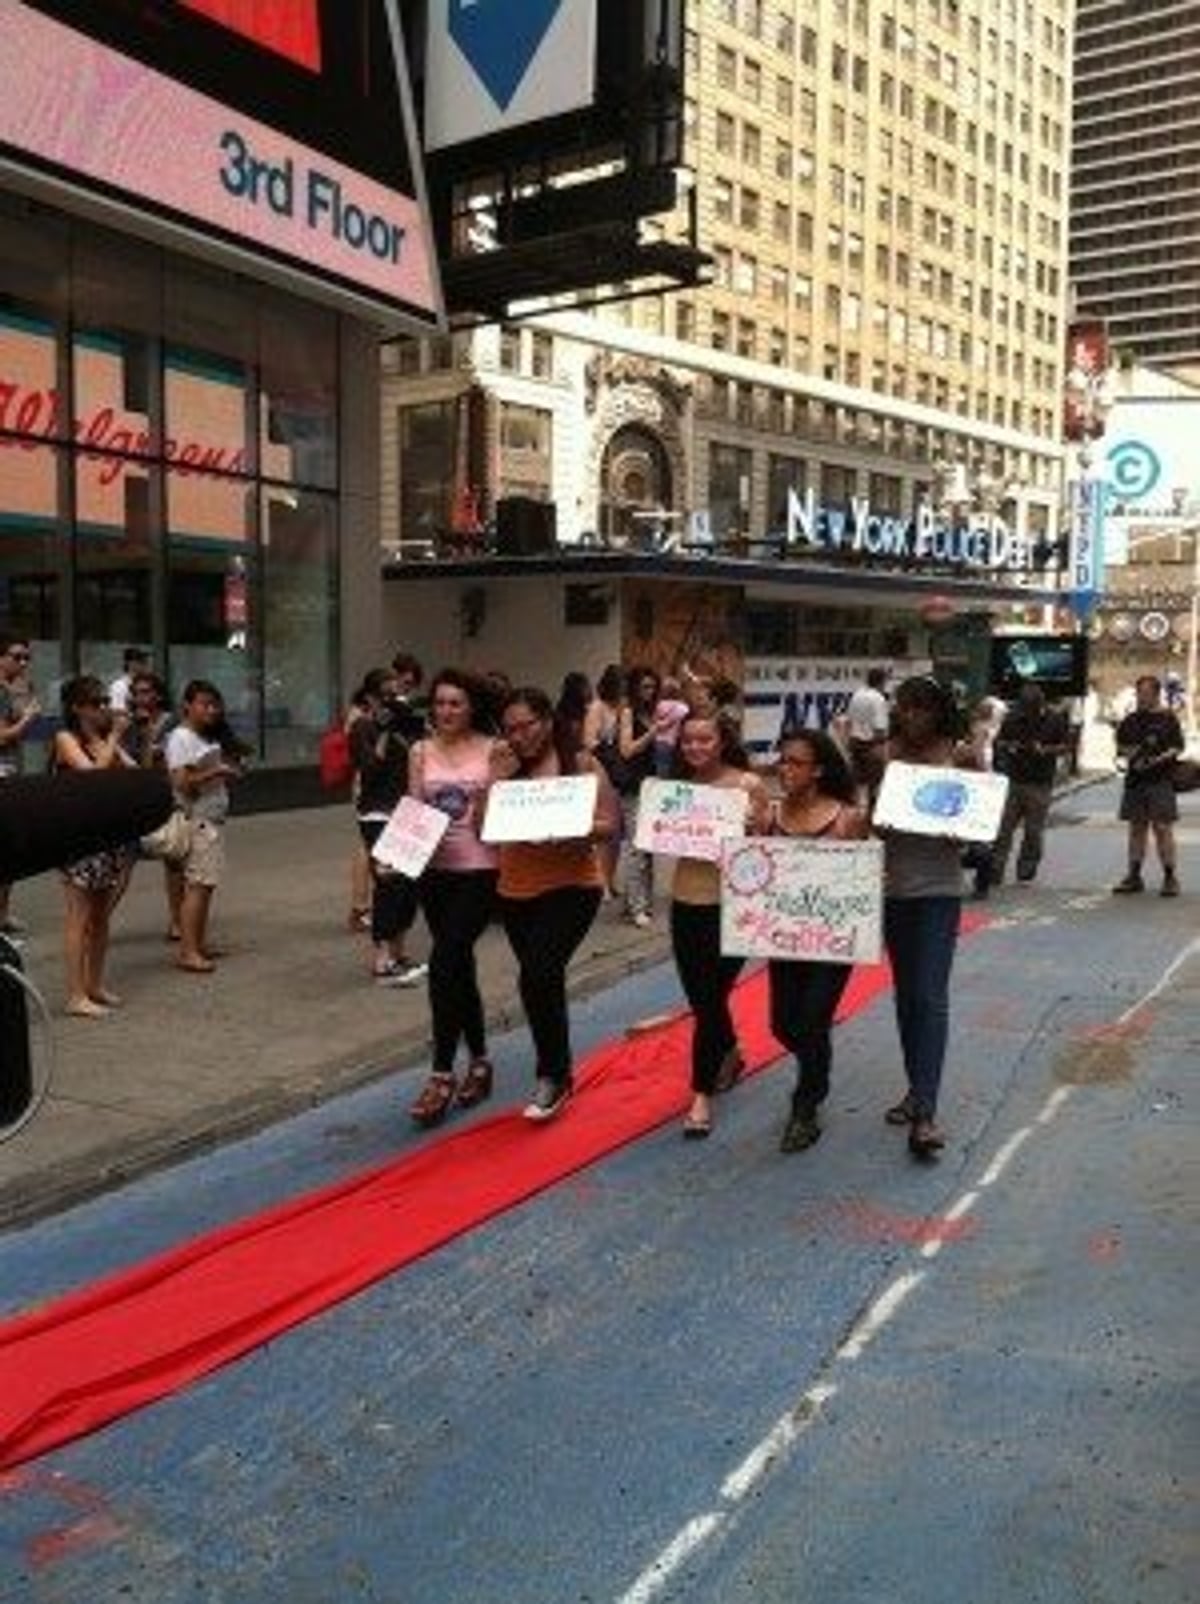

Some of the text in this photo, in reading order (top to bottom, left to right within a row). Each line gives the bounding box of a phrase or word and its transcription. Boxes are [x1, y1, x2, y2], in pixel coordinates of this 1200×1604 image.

[219, 131, 405, 265] 3rd Floor
[0, 381, 254, 485] Wlgreens
